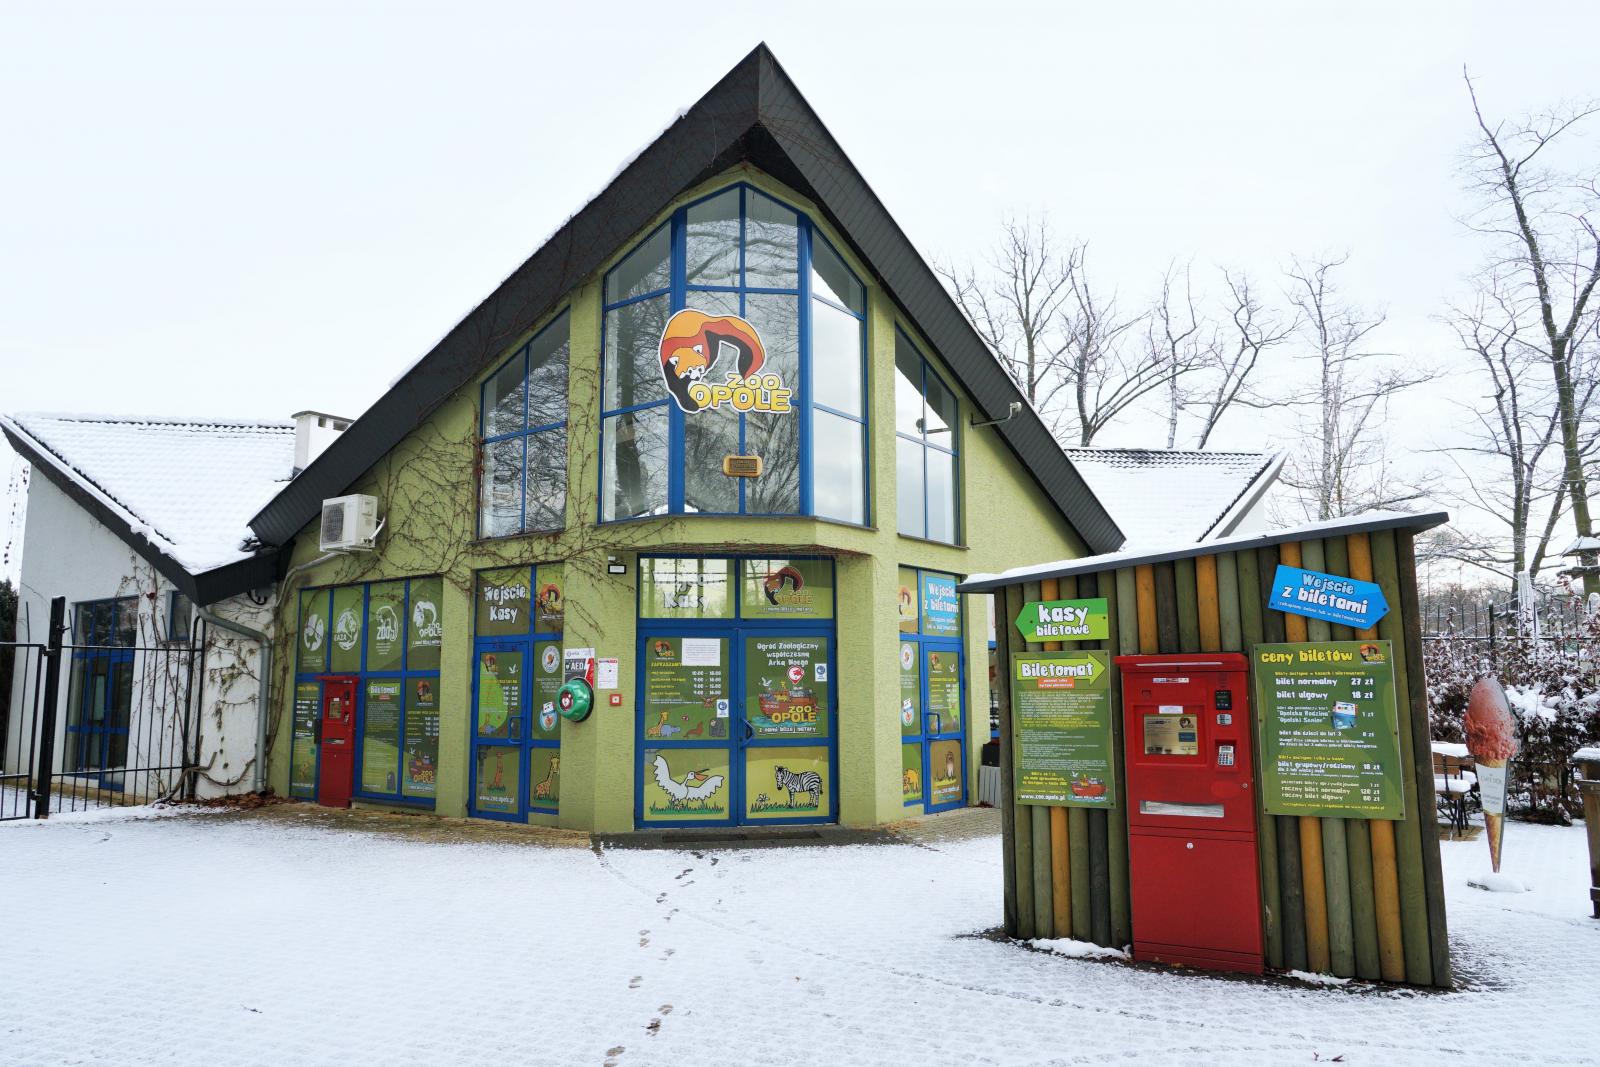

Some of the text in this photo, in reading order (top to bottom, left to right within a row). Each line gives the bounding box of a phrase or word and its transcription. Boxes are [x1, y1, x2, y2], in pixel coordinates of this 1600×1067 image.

[726, 372, 780, 390] ZOO
[689, 384, 791, 411] OPOLE
[928, 582, 956, 599] Wejście
[1302, 573, 1354, 594] Wejście
[484, 584, 525, 605] Wejście
[1282, 586, 1368, 613] z biletami
[930, 598, 959, 613] biletami
[489, 606, 518, 623] Kasy
[419, 628, 443, 638] OPOLE
[1036, 624, 1090, 636] biletowe
[757, 642, 819, 651] Ogród Zoologiczny
[788, 659, 809, 667] Noego
[1261, 648, 1353, 665] ceny biletów
[570, 662, 584, 670] AED
[1021, 662, 1094, 677] Biletomat
[1275, 677, 1295, 686] bilet
[1297, 677, 1338, 687] normalny
[1364, 677, 1374, 685] zł
[1276, 691, 1374, 700] bilet ulgowy 18 zł
[789, 705, 812, 713] ZOO
[771, 712, 817, 723] OPOLE
